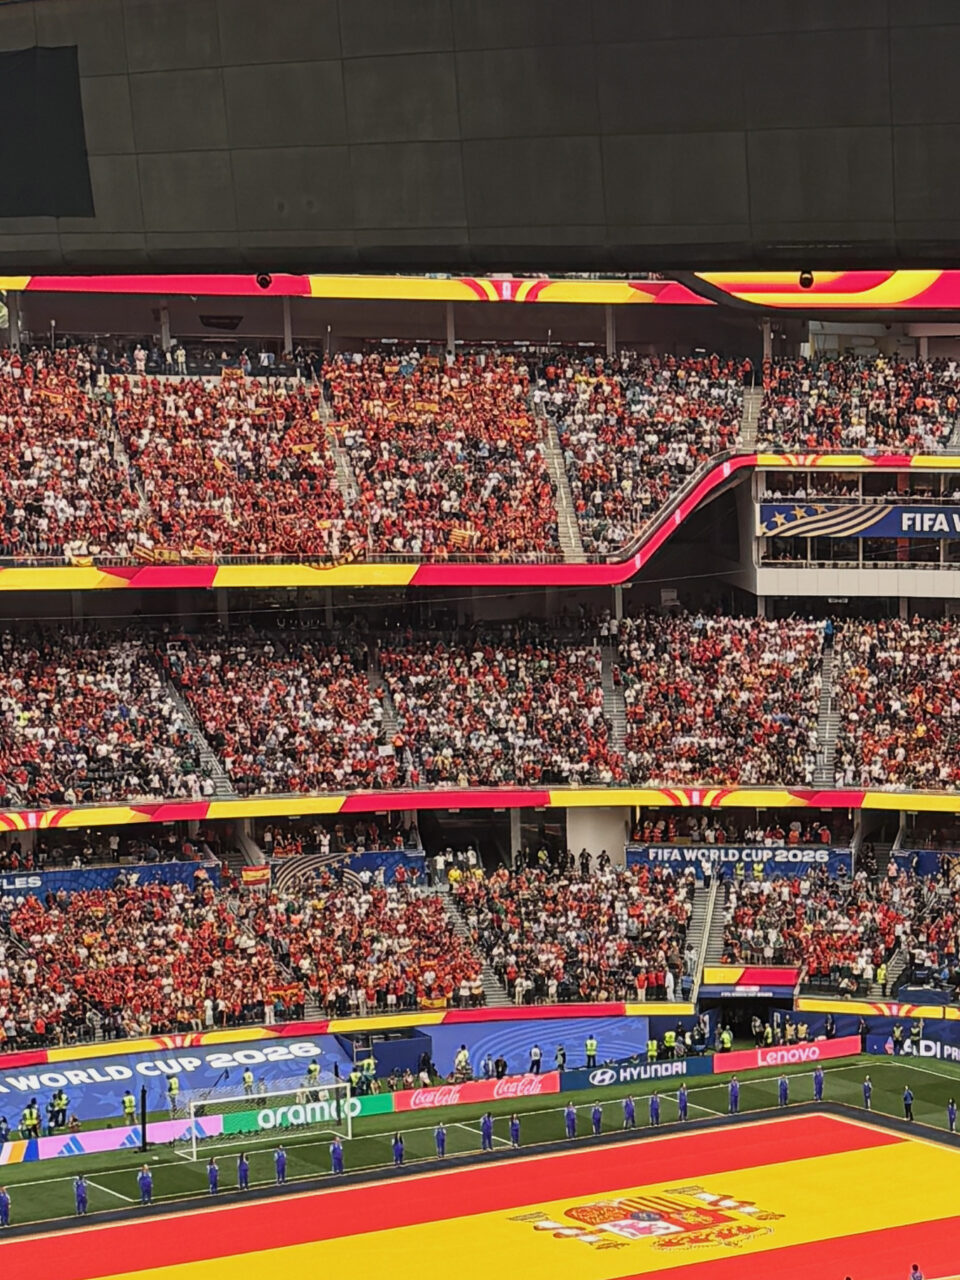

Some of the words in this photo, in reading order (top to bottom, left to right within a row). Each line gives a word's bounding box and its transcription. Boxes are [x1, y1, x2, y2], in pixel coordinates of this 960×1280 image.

[901, 513, 949, 532] FIFA
[649, 849, 682, 861] FIFA
[684, 849, 740, 861] WORLD
[742, 849, 772, 862] CUP
[775, 850, 829, 862] 2026
[0, 876, 42, 890] LES
[5, 1065, 133, 1091] WORLD
[136, 1054, 202, 1076] CUP
[205, 1042, 322, 1069] 2026
[757, 1046, 820, 1067] Lenovo
[619, 1061, 687, 1082] HYUNDAI
[257, 1097, 361, 1129] aramco
